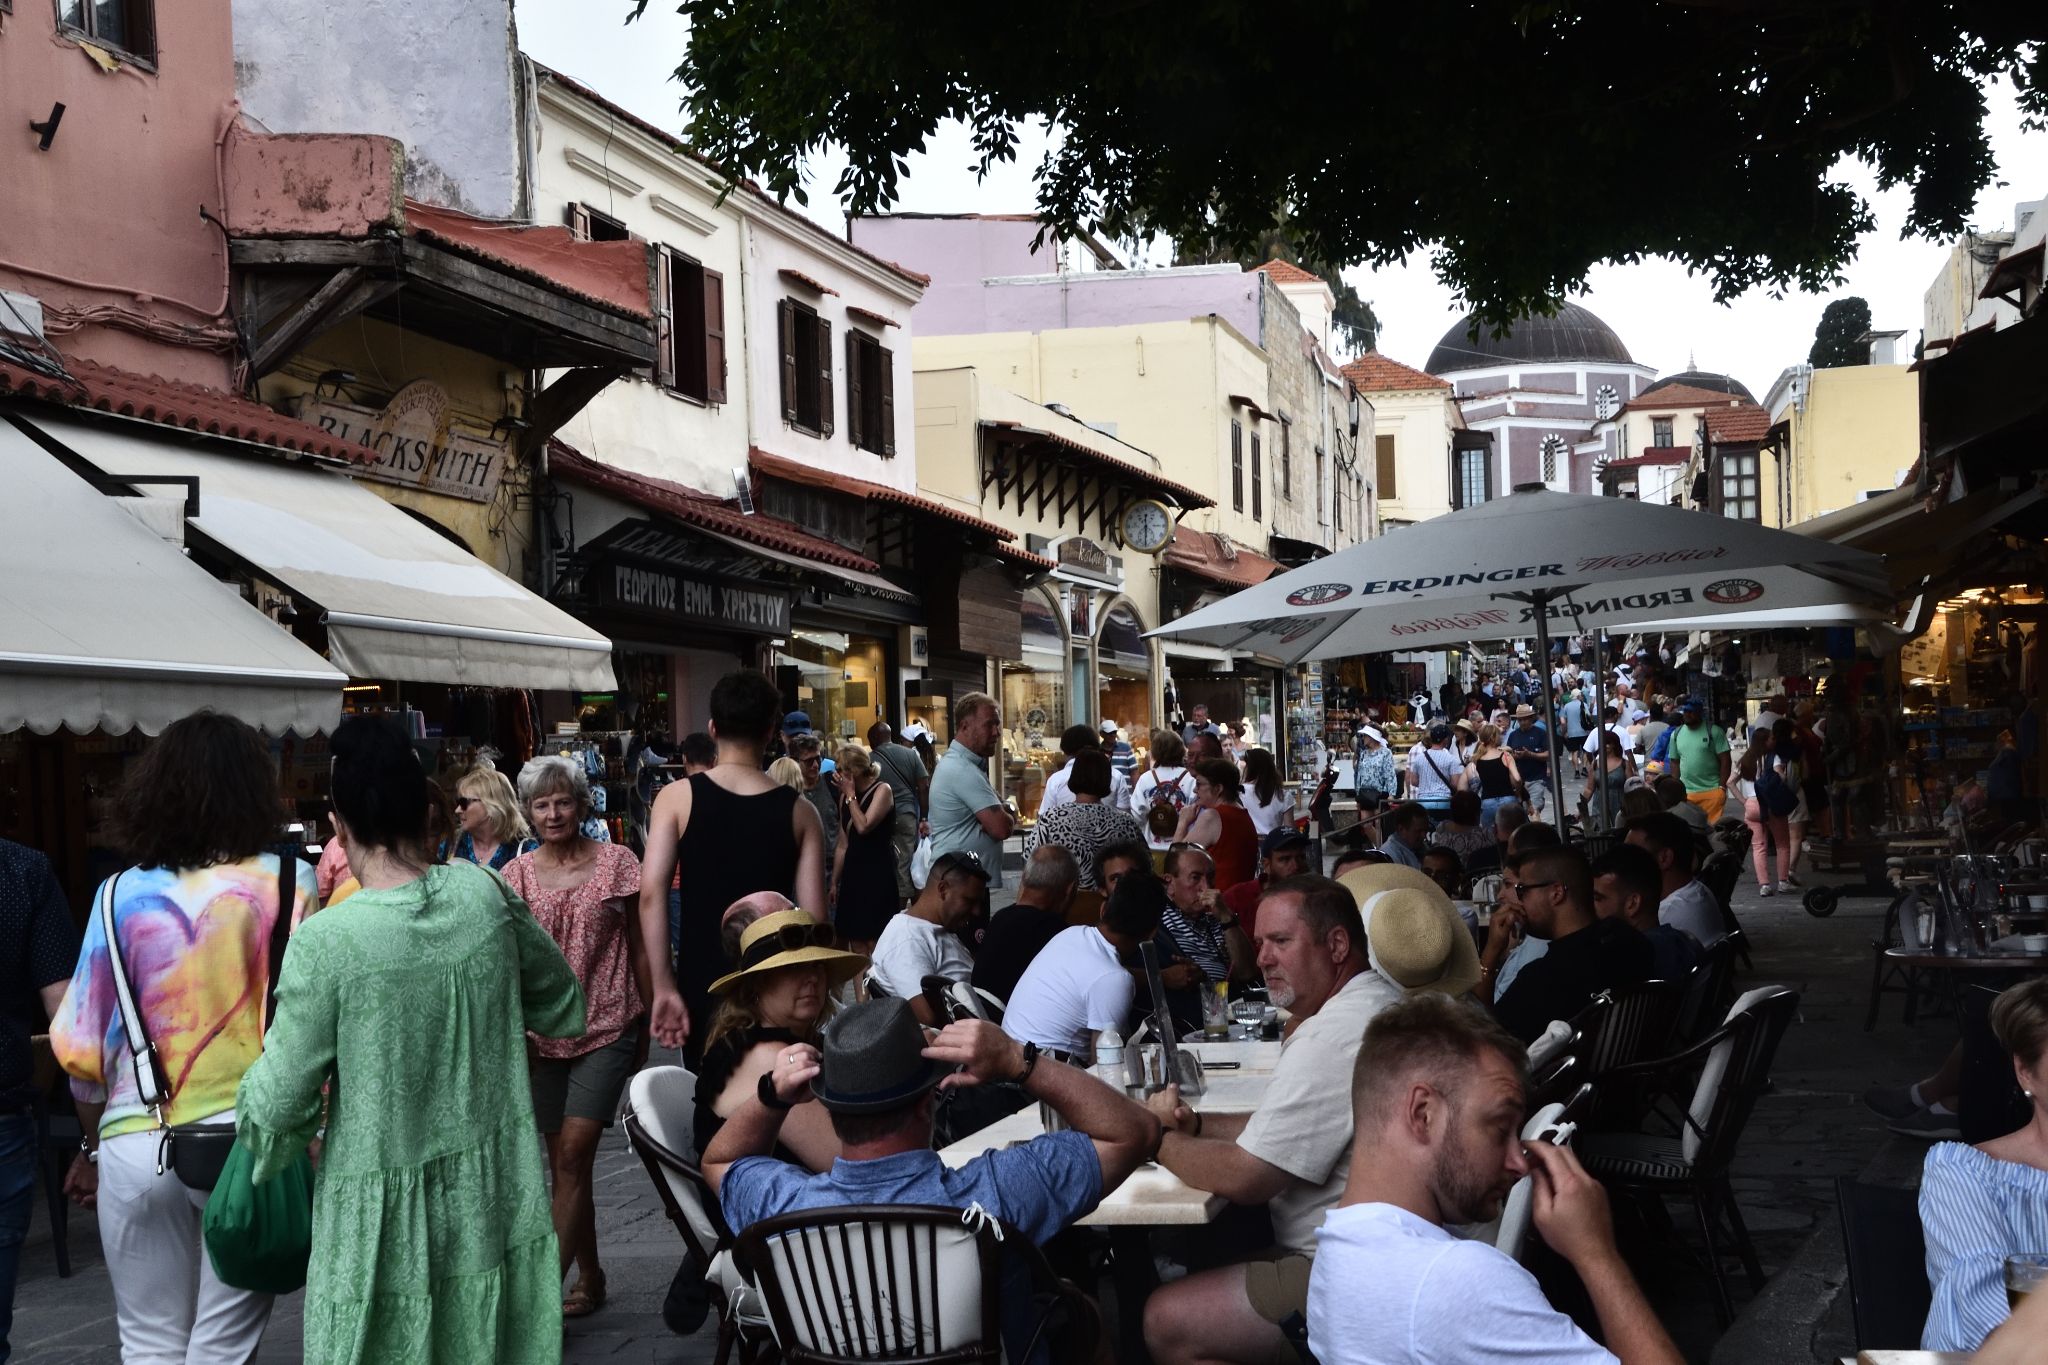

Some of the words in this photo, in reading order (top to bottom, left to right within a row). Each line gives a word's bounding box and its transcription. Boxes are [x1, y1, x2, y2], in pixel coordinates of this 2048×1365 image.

[615, 566, 676, 610] ΓΕΩΡΓΙΟΣ
[684, 580, 716, 617] ΕΜΜ.
[722, 587, 784, 627] ΧΡΗΣΤΟΥ
[1361, 563, 1567, 595] ERDINGER
[1576, 546, 1729, 572] Weißbier
